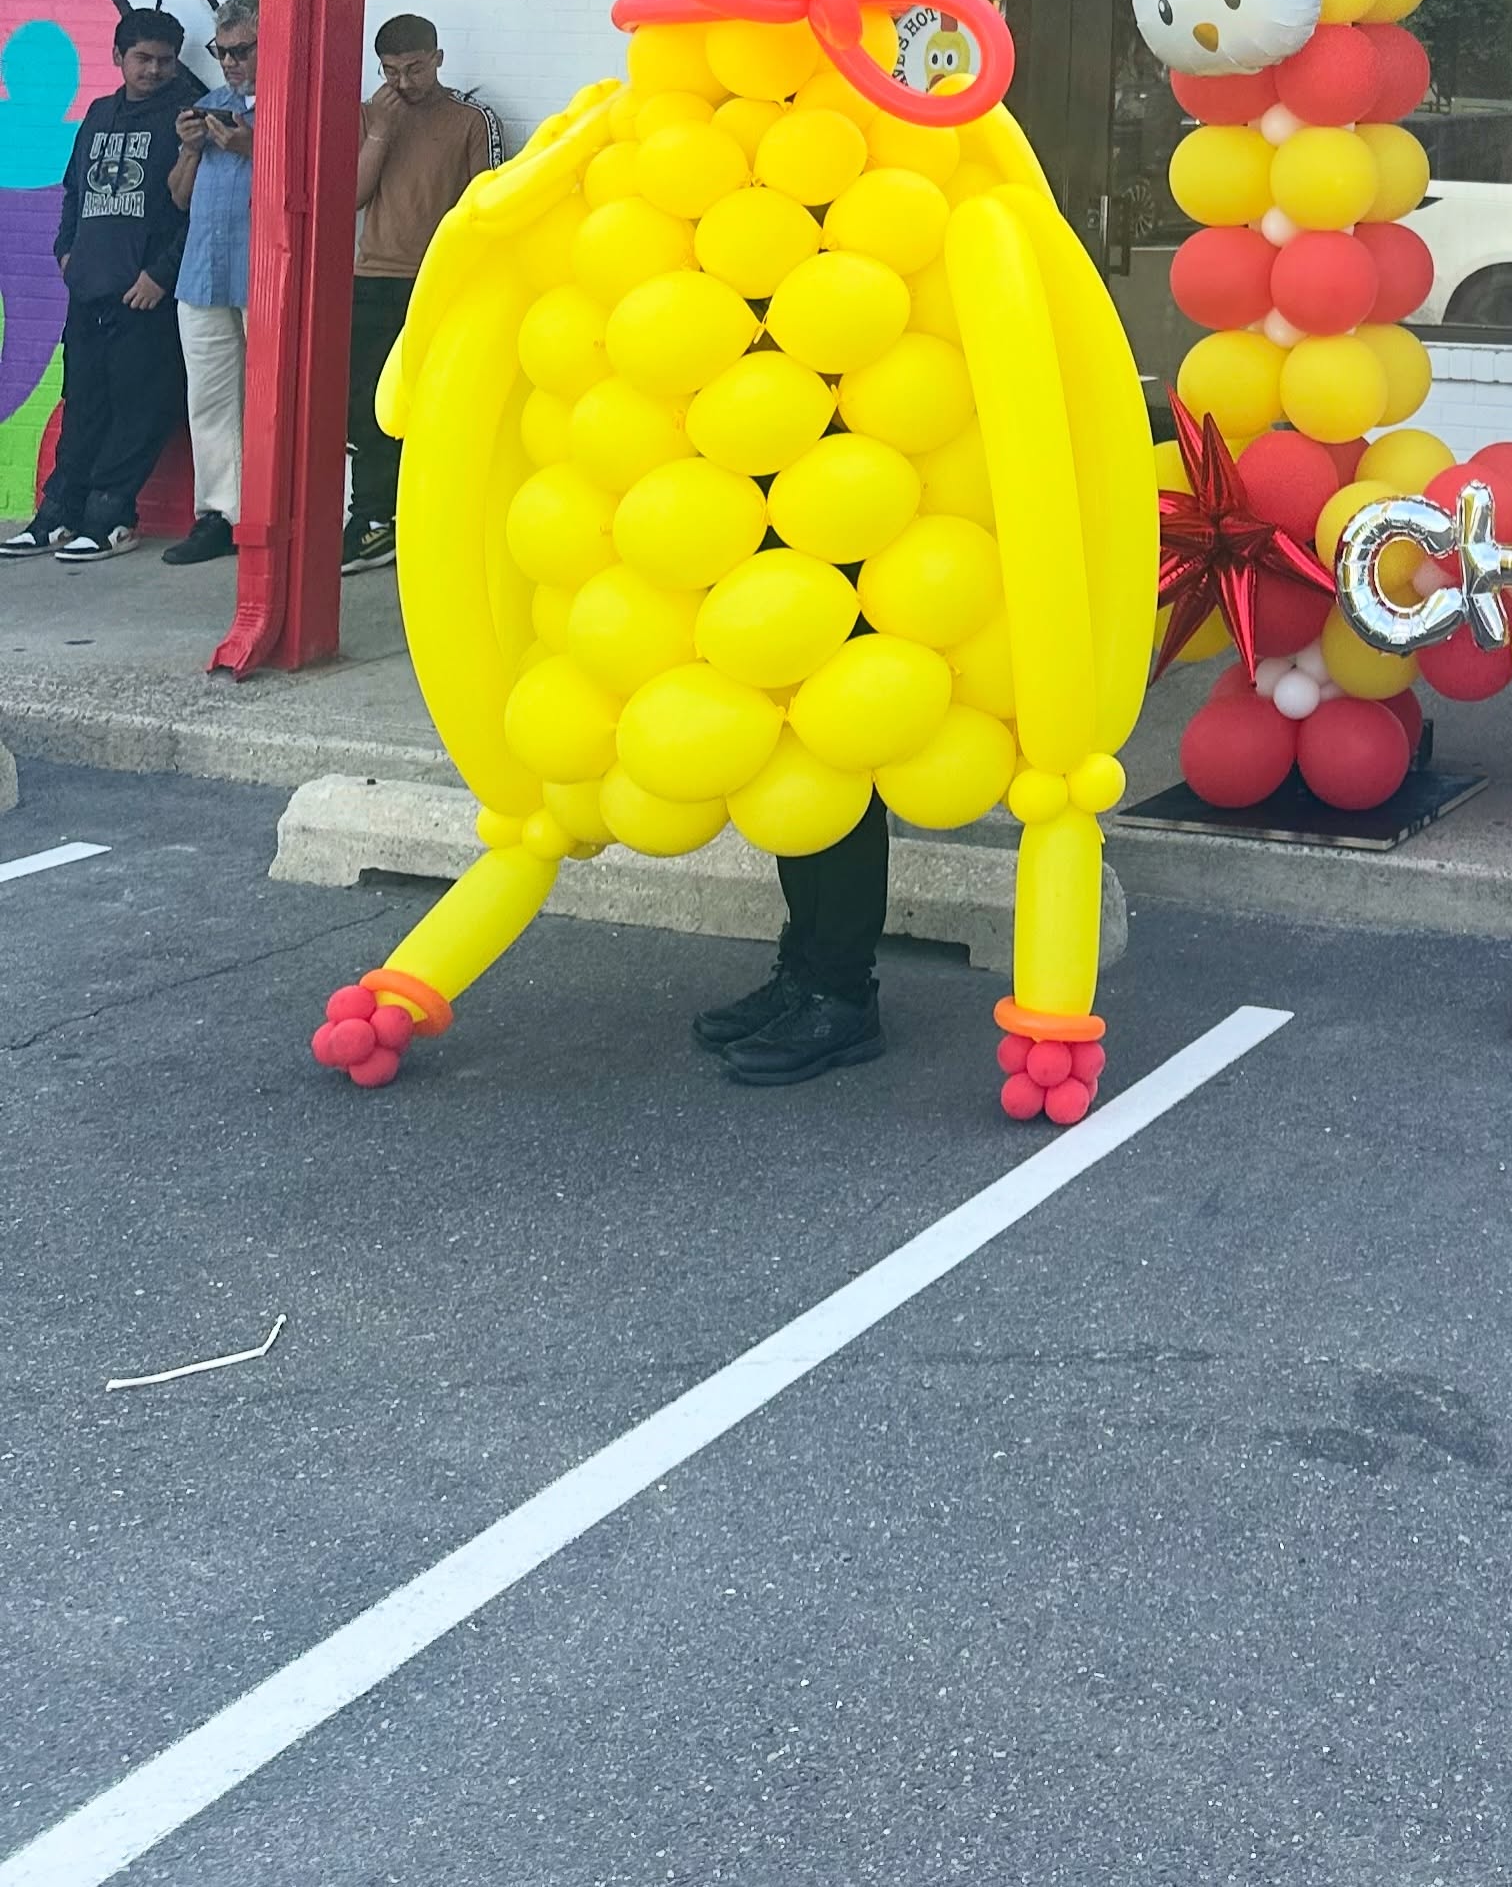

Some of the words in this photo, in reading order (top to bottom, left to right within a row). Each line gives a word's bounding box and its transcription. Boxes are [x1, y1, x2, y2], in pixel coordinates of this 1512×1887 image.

[903, 8, 938, 37] HOT
[90, 132, 151, 160] UNDER
[82, 191, 145, 218] ARMOUR
